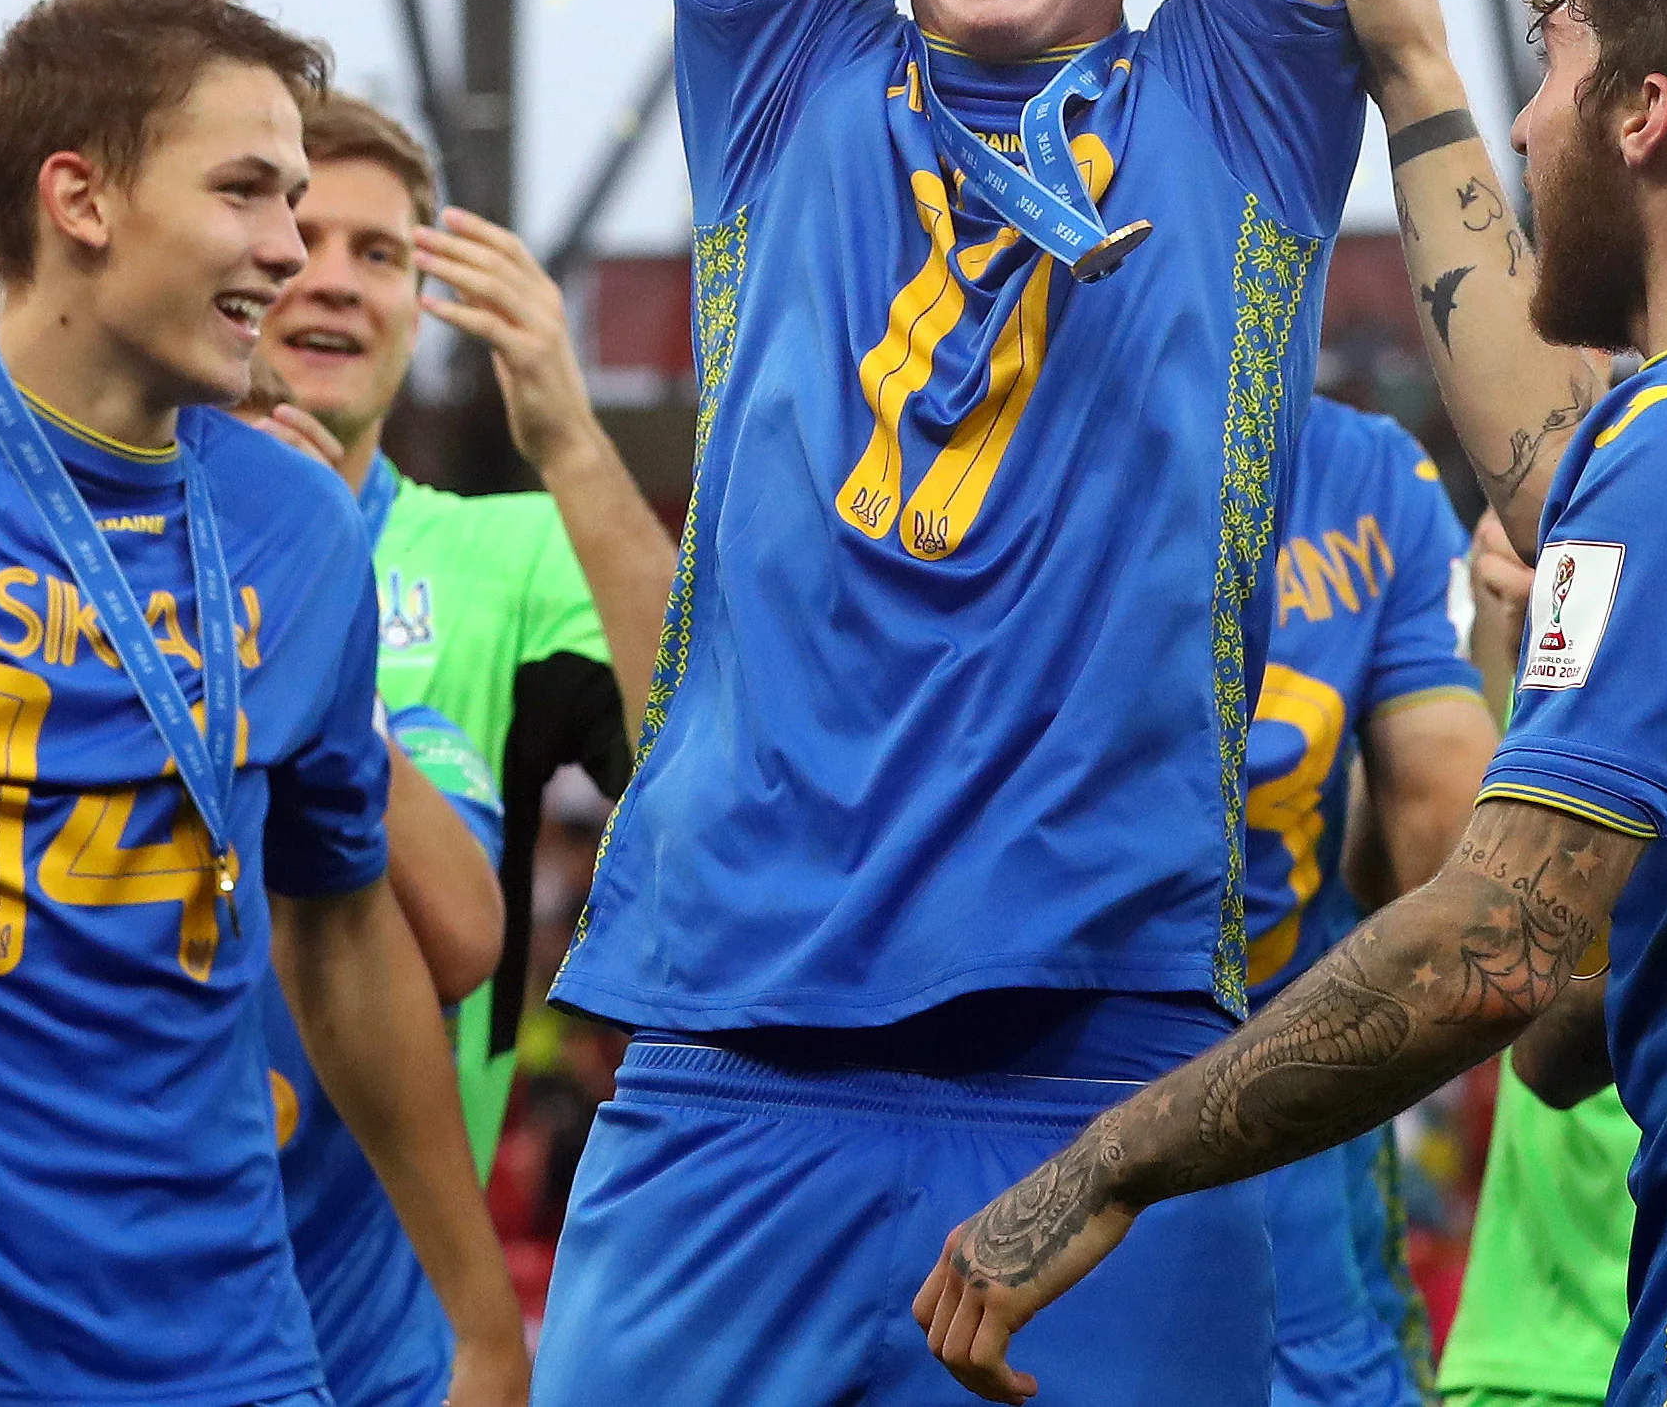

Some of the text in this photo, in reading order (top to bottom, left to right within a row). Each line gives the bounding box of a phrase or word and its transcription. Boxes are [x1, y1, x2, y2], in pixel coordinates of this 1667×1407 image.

[1036, 134, 1056, 165] FIFA
[1019, 194, 1044, 221] FIFA
[1055, 222, 1083, 247] FIFA
[1527, 666, 1556, 677] LAND
